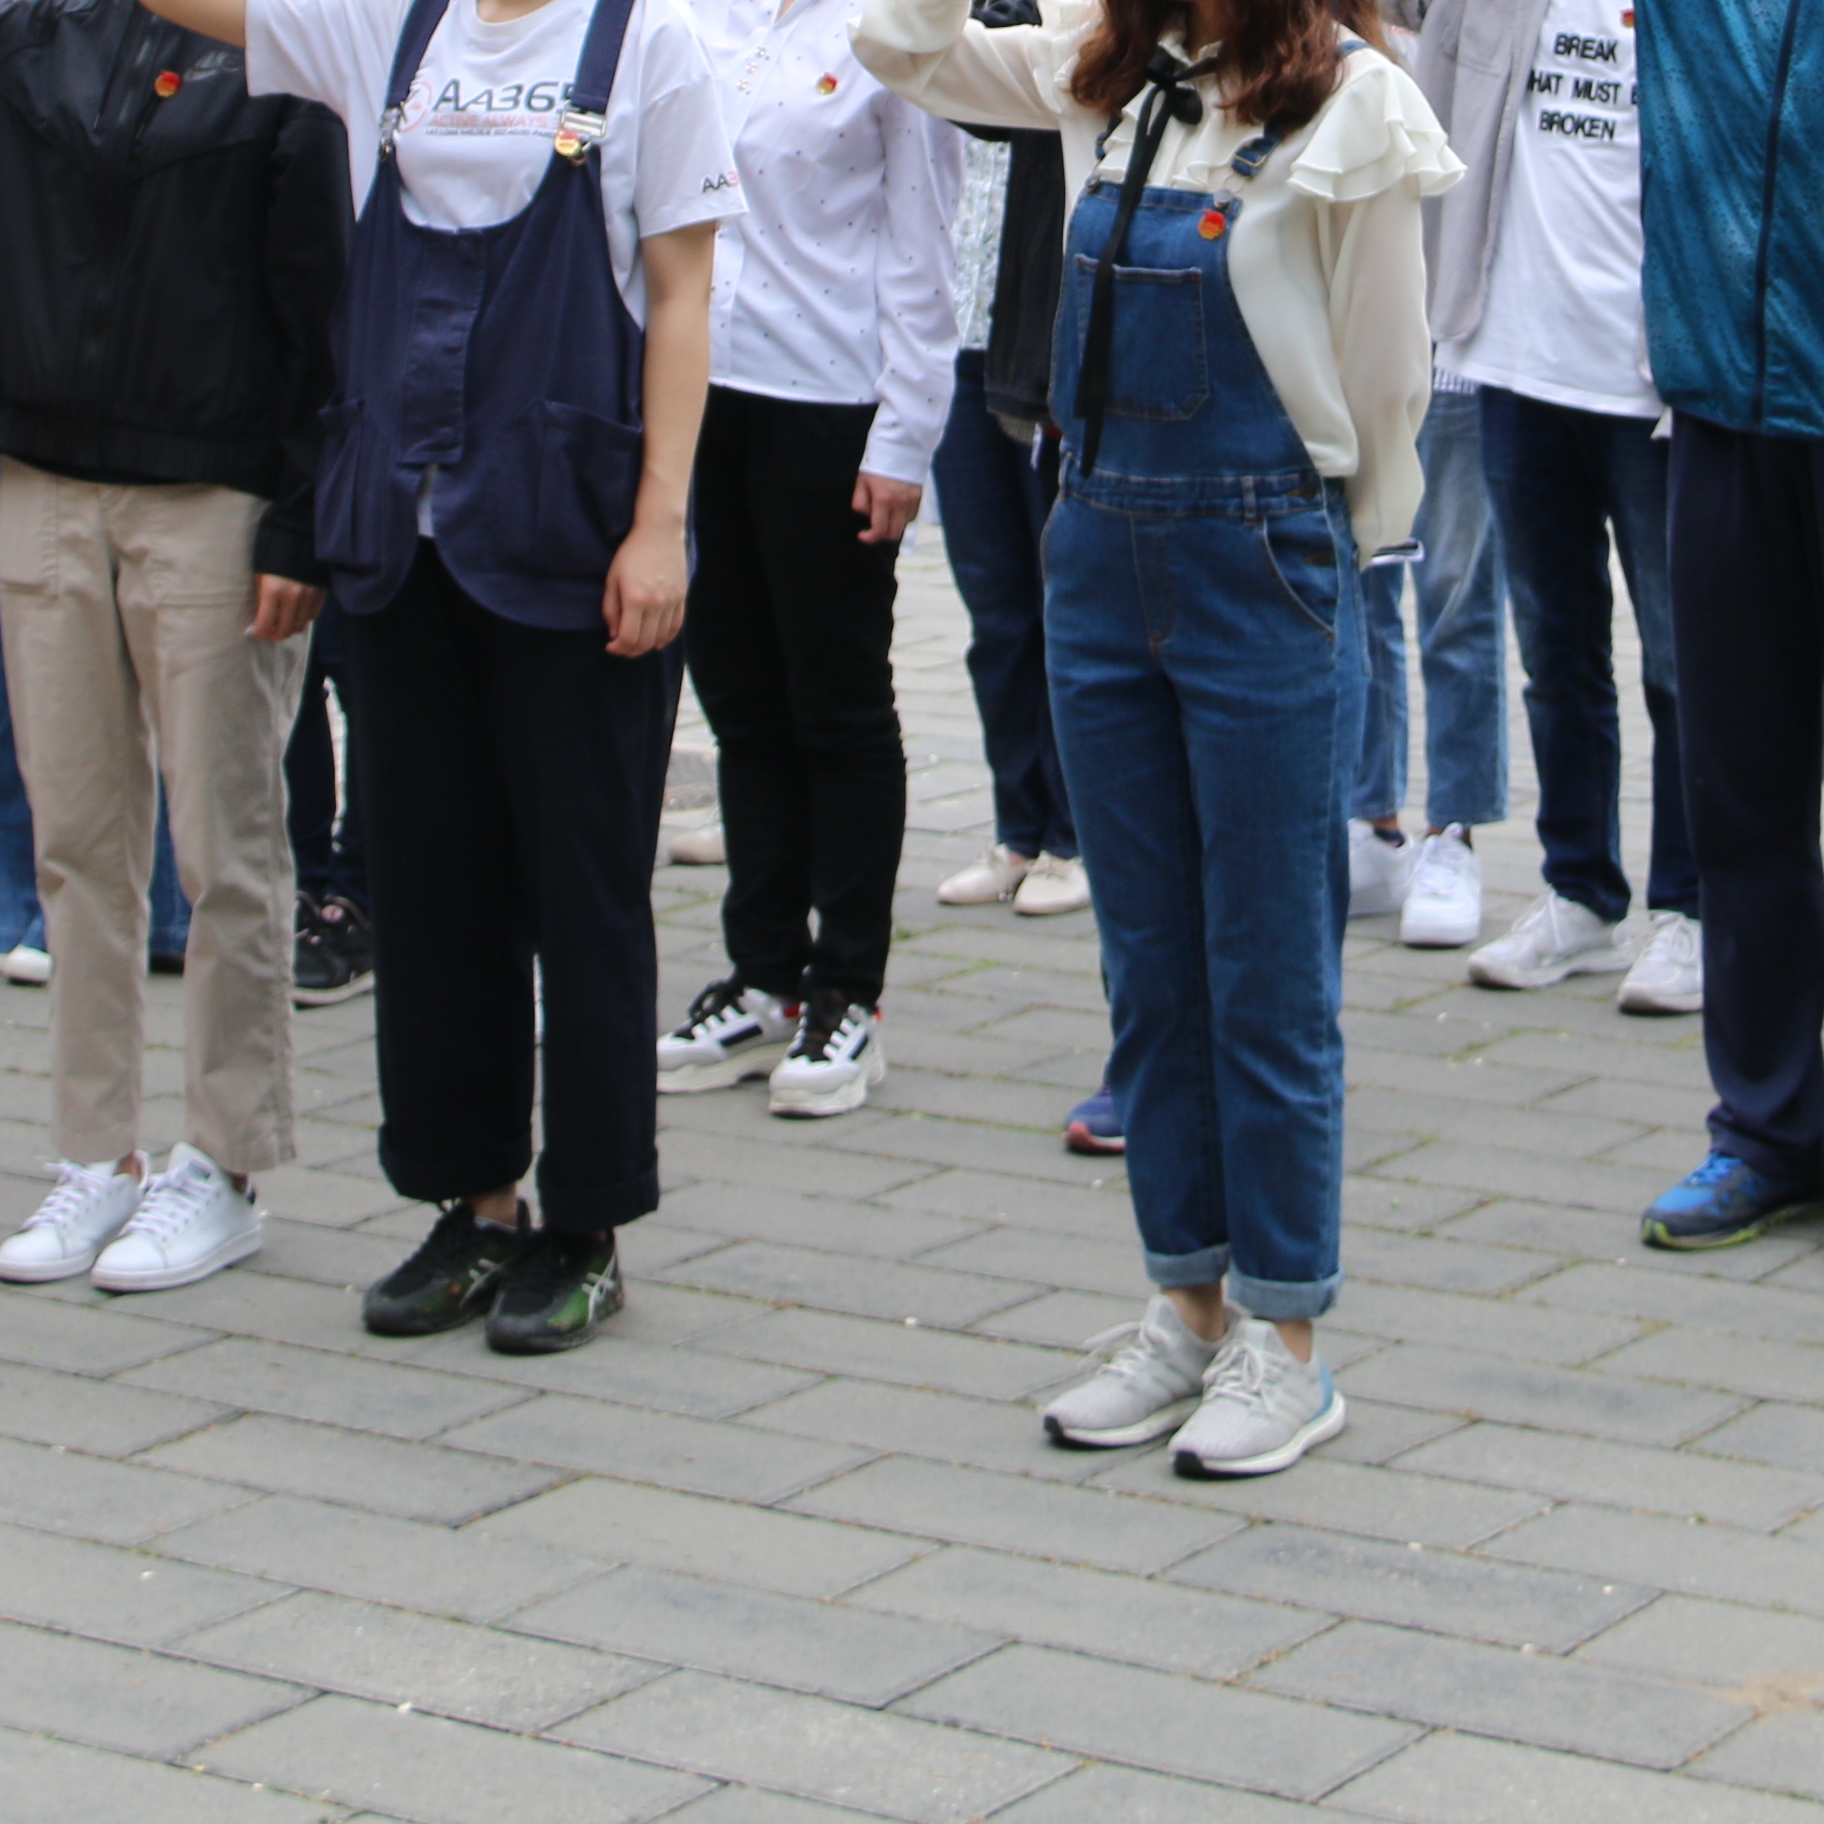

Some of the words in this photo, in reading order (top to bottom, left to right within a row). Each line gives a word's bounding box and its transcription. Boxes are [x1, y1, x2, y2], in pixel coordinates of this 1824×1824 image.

[1555, 33, 1618, 63] BREAK
[1528, 69, 1564, 94] HAT
[1571, 77, 1621, 104] MUST
[1540, 110, 1615, 140] BROKEN
